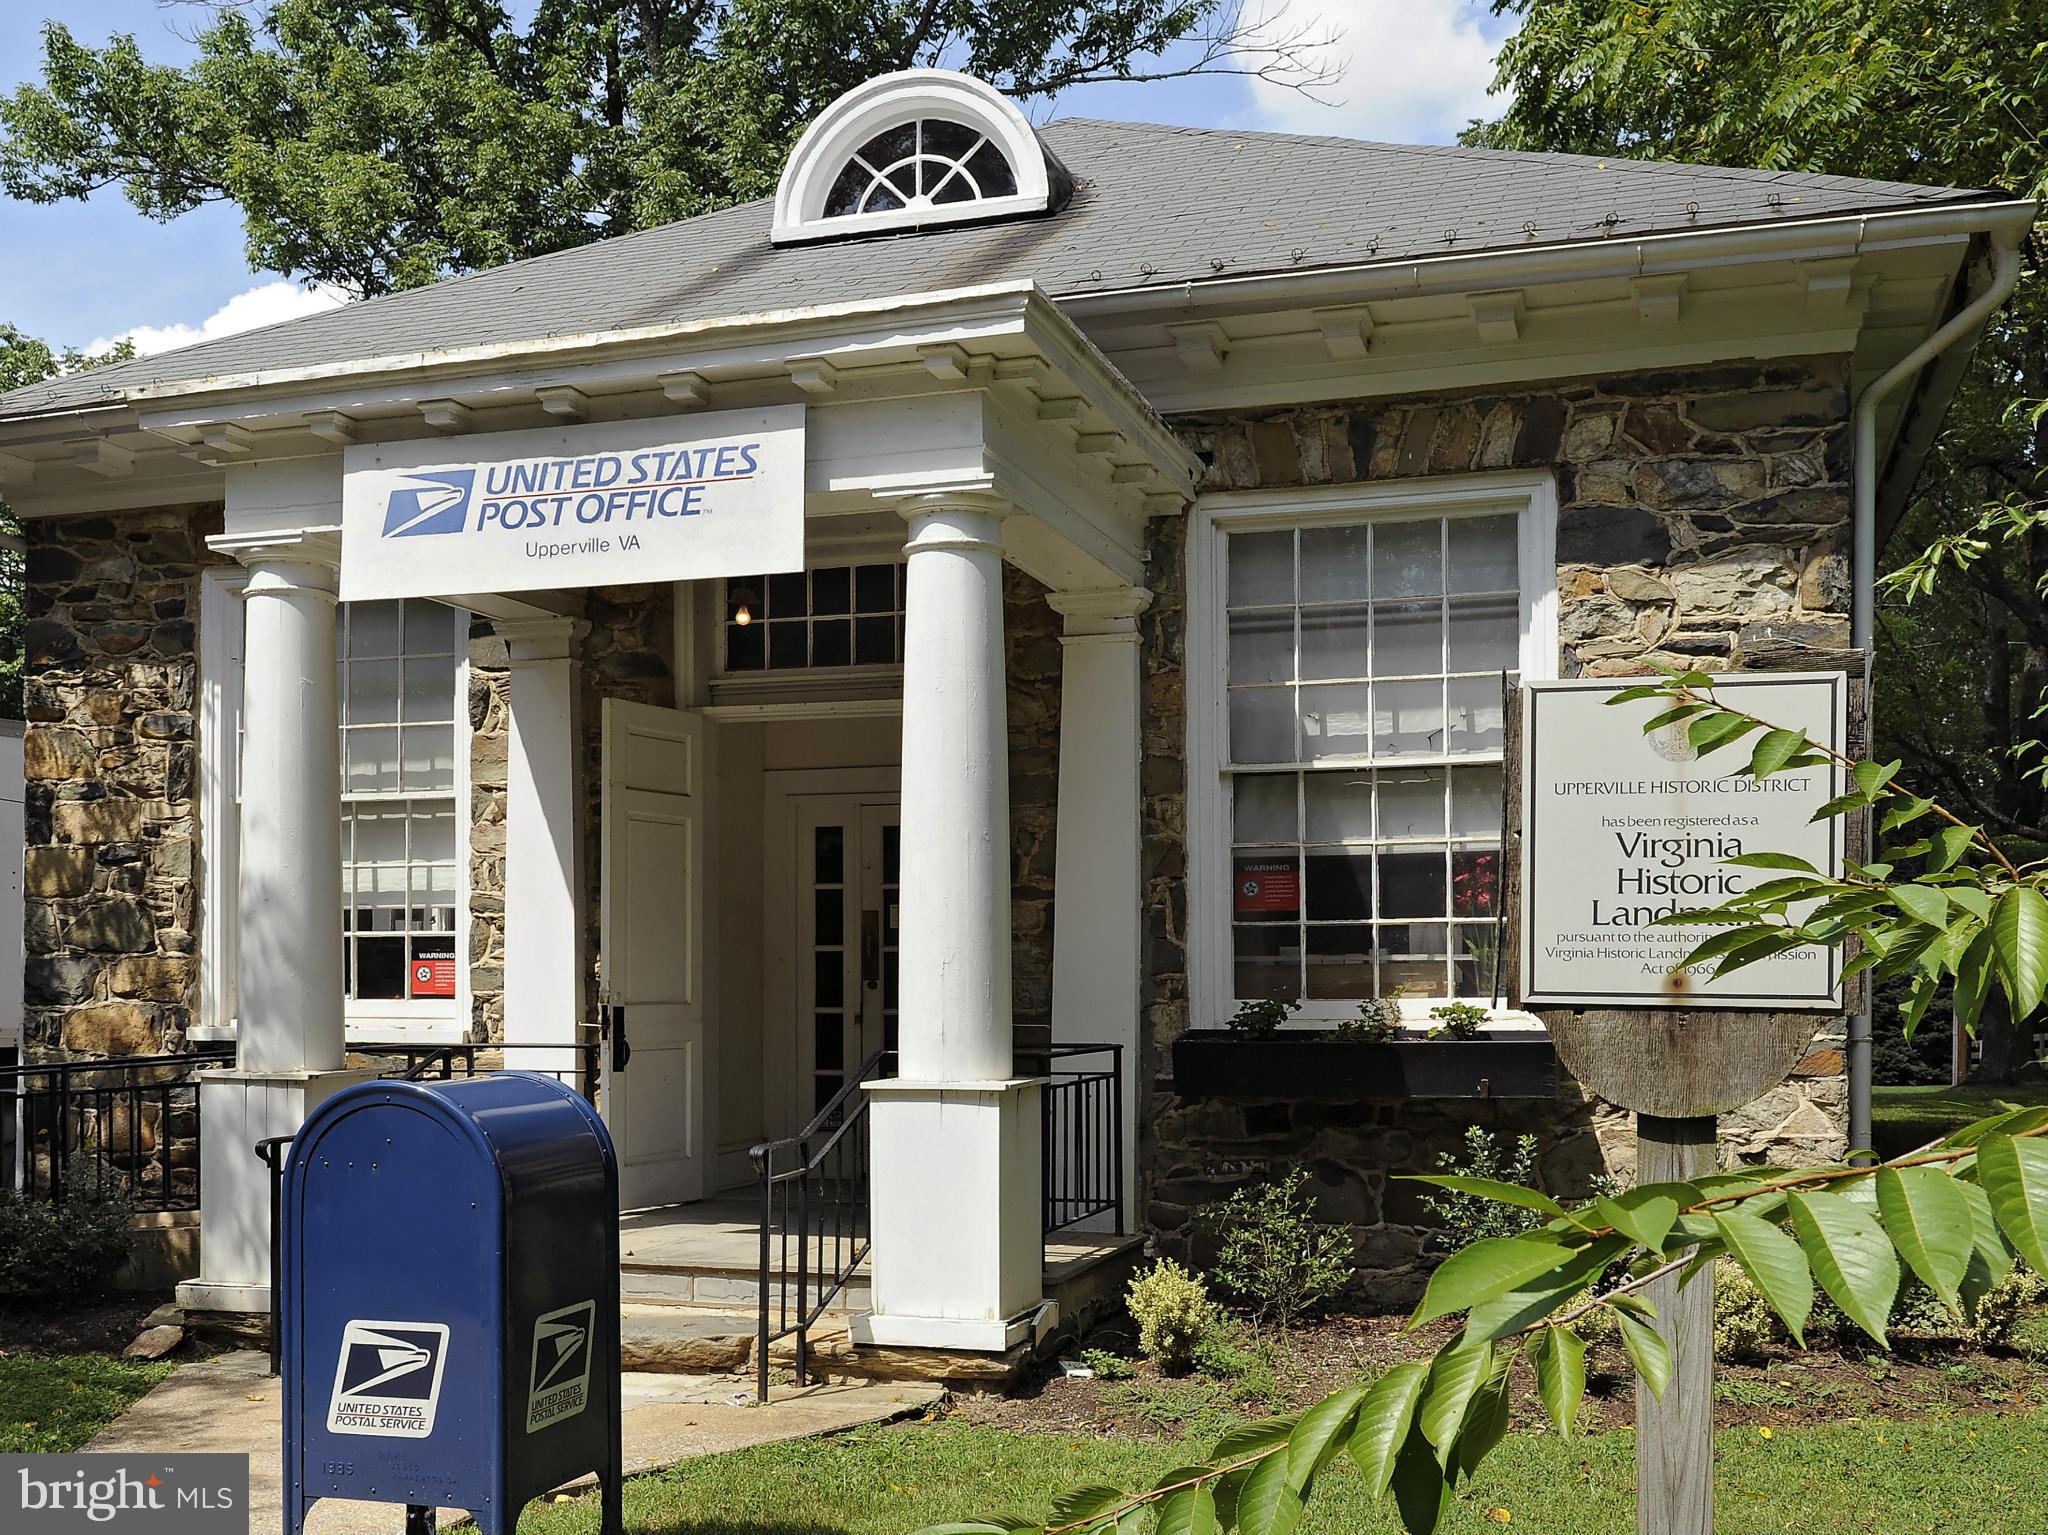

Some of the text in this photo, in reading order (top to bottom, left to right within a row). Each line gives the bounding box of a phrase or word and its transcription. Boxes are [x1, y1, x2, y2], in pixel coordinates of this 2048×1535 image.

[486, 443, 761, 496] UNITED STATES
[477, 485, 706, 532] POST OFFICE
[525, 534, 641, 560] Upperville VA
[1554, 778, 1812, 796] UPPERVILLE HISTORIC DISTRICT
[1602, 814, 1759, 830] has been registered as a
[1615, 831, 1743, 868] Virginia
[1243, 864, 1290, 872] WARNING
[1617, 868, 1744, 896] Historic
[1556, 930, 1713, 946] pursuant to the authorit
[1545, 947, 1595, 963] Virginia
[1597, 946, 1647, 960] Historic
[1640, 962, 1716, 977] Act of 1966
[532, 1382, 581, 1411] UNITED STATES
[337, 1402, 423, 1417] UNITED STATES
[530, 1395, 585, 1426] POSTAL SERVICE
[335, 1415, 426, 1431] POSTAL SERVICE
